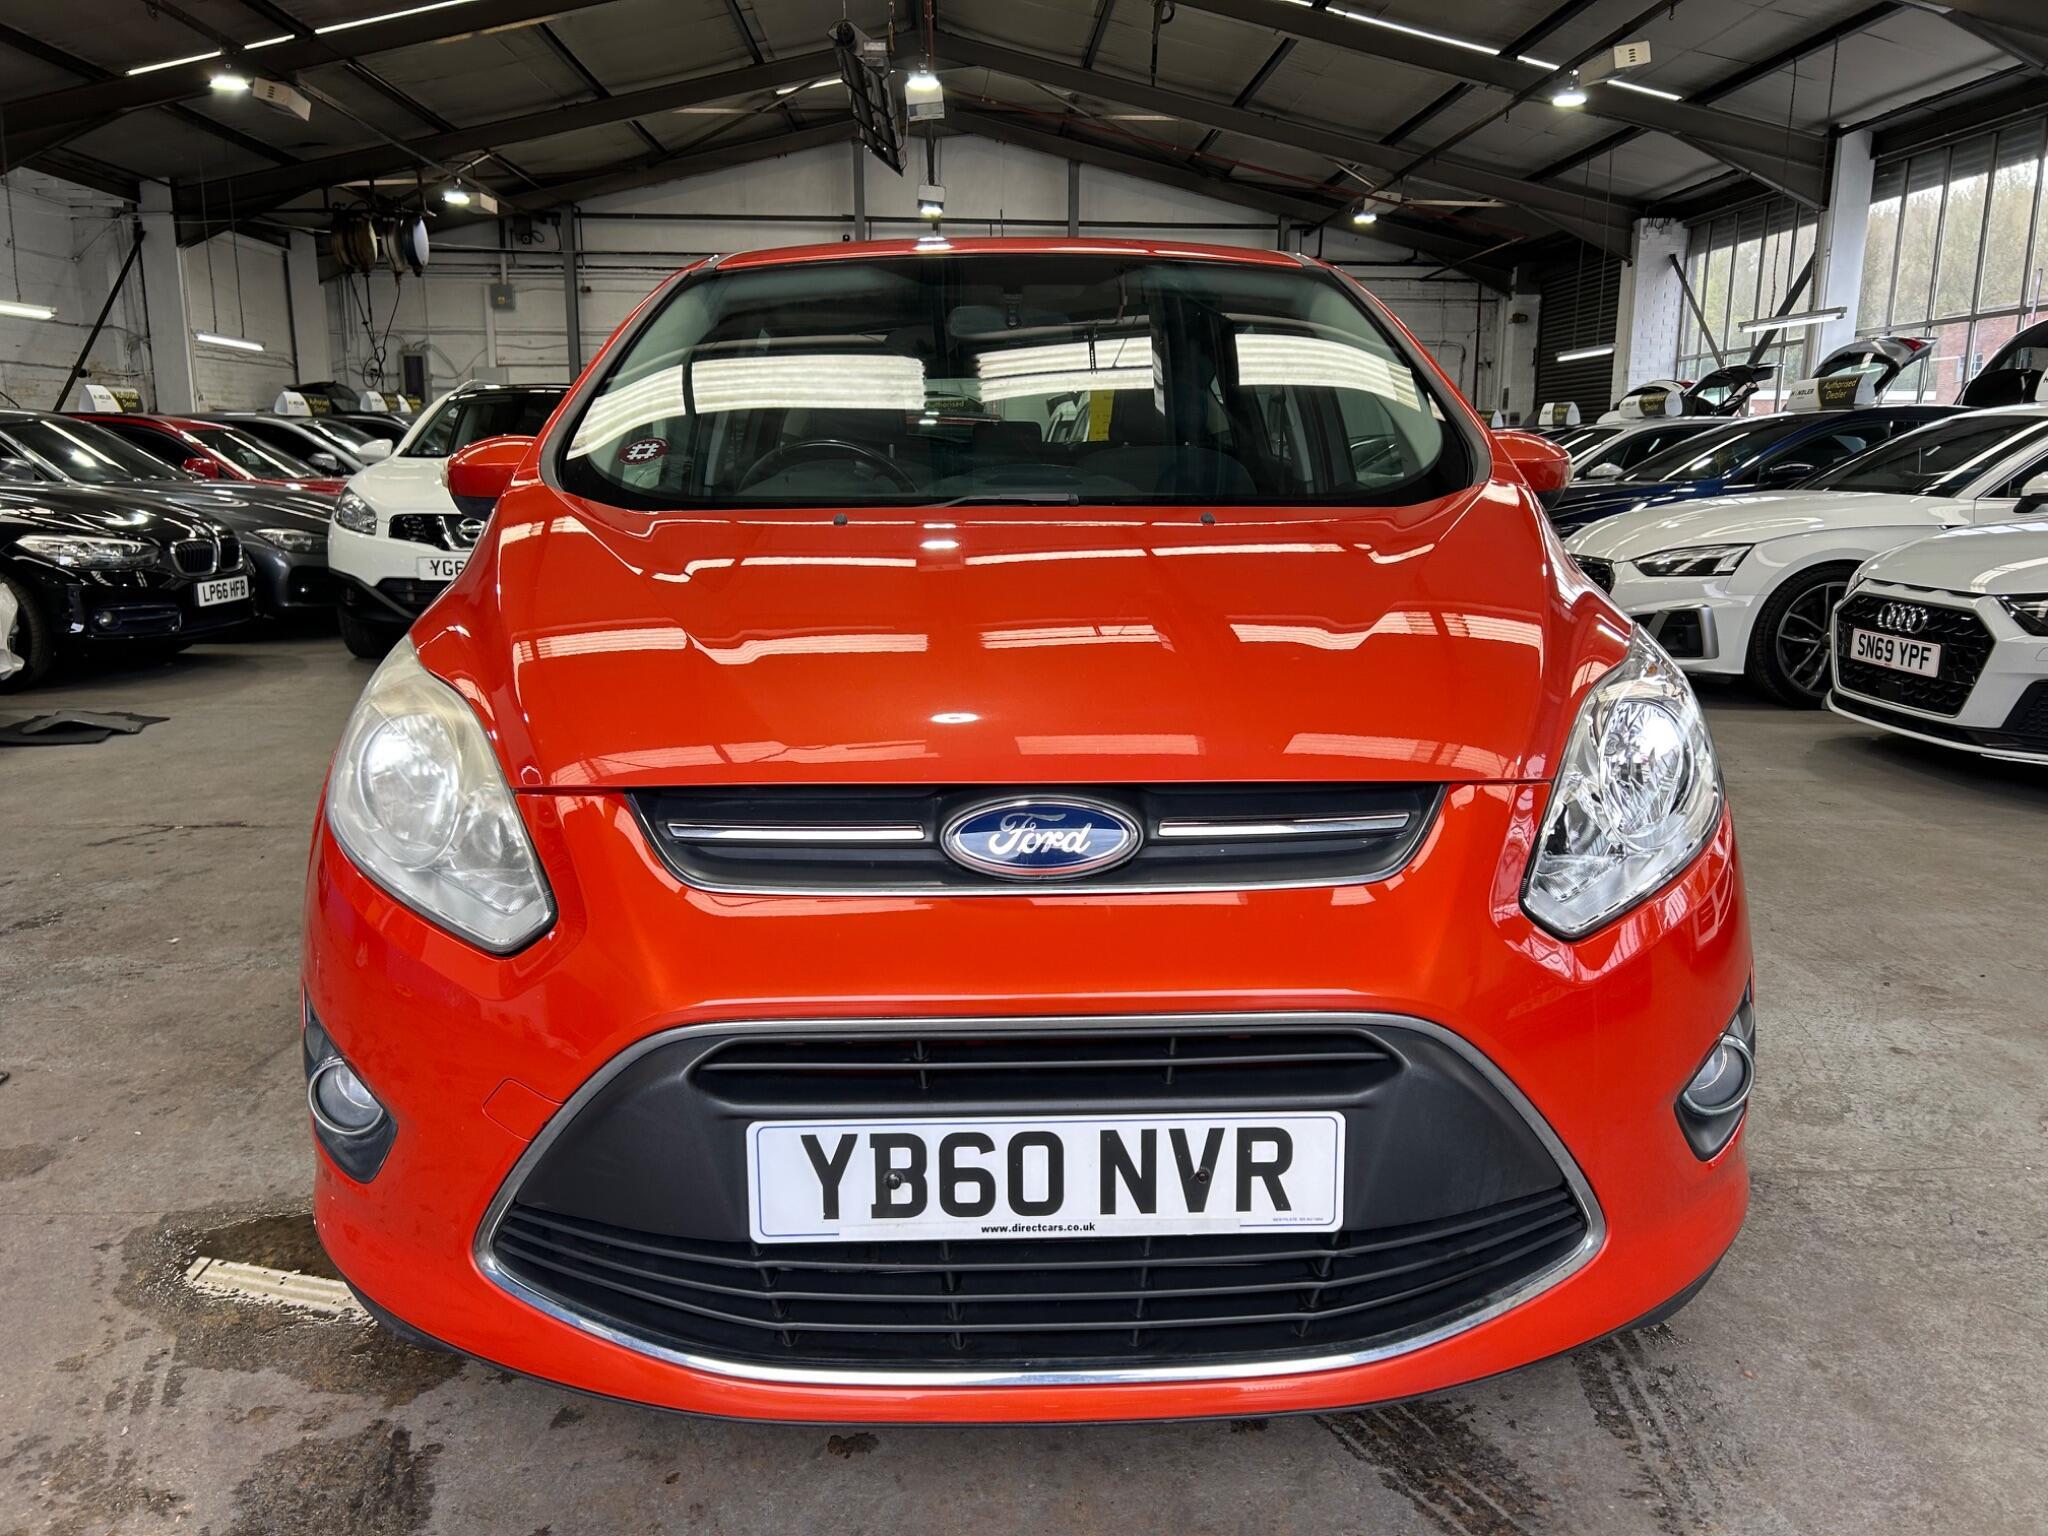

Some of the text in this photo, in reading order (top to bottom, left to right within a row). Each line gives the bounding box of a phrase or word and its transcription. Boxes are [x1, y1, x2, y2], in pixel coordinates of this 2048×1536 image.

[203, 580, 246, 602] LP66 HFB
[1857, 633, 1932, 670] SN69 YPF
[989, 813, 1093, 854] Ford
[800, 1127, 1293, 1220] YB60 NVR
[981, 1222, 1096, 1233] www.directcars.co.uk
